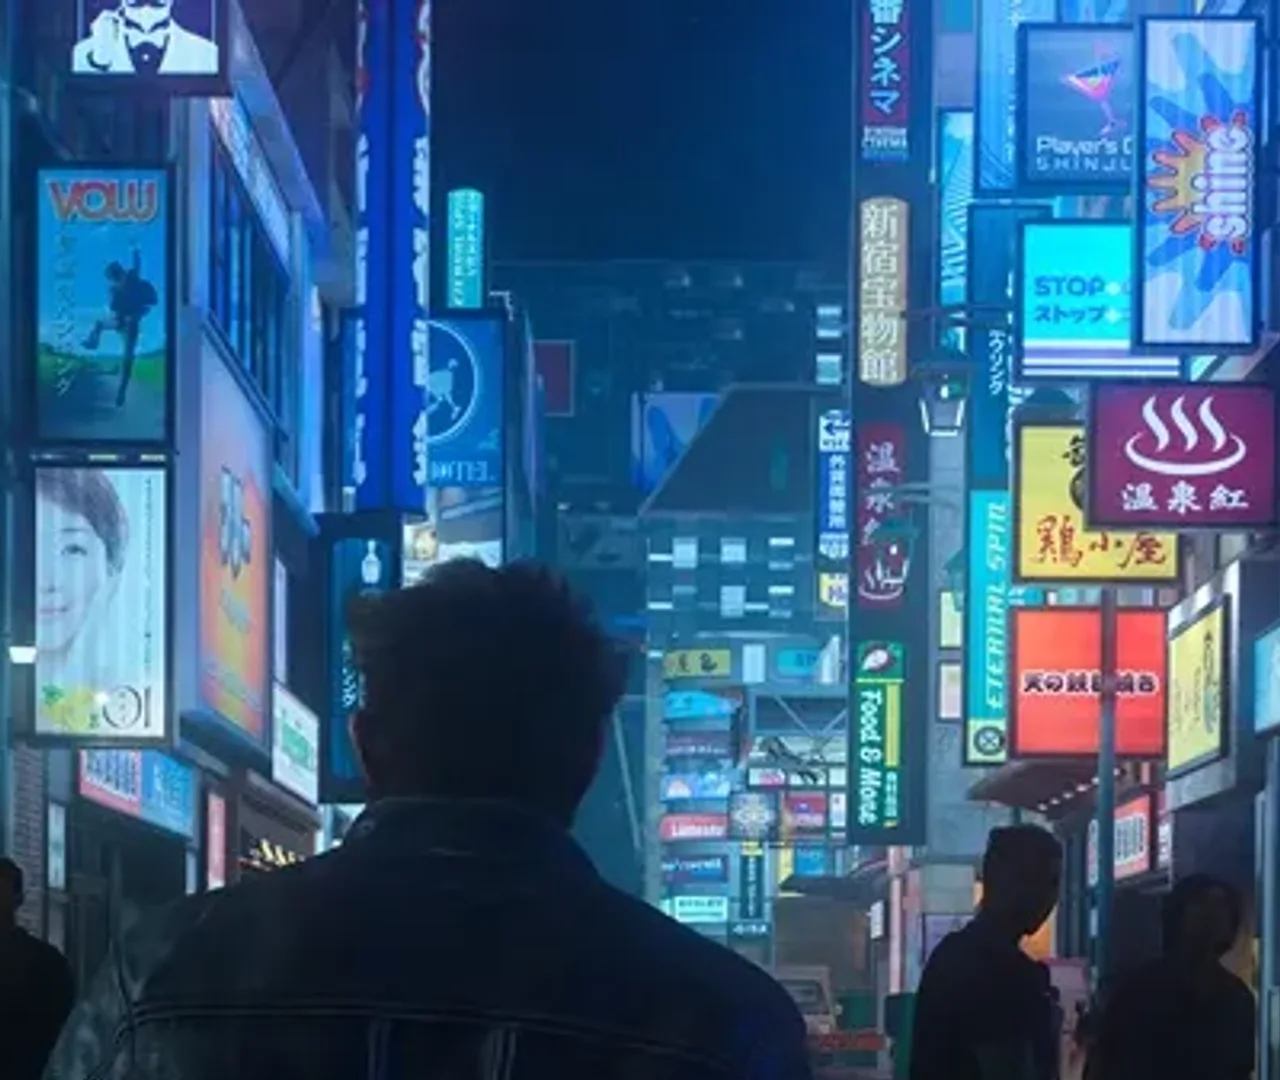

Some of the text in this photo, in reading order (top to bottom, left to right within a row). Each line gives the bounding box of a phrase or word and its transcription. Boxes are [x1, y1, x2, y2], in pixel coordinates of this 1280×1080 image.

[1036, 136, 1118, 158] Player's
[1192, 126, 1250, 237] shine
[1034, 275, 1106, 297] STOP
[986, 579, 1007, 709] ETERNAL
[859, 690, 882, 825] Food & More
